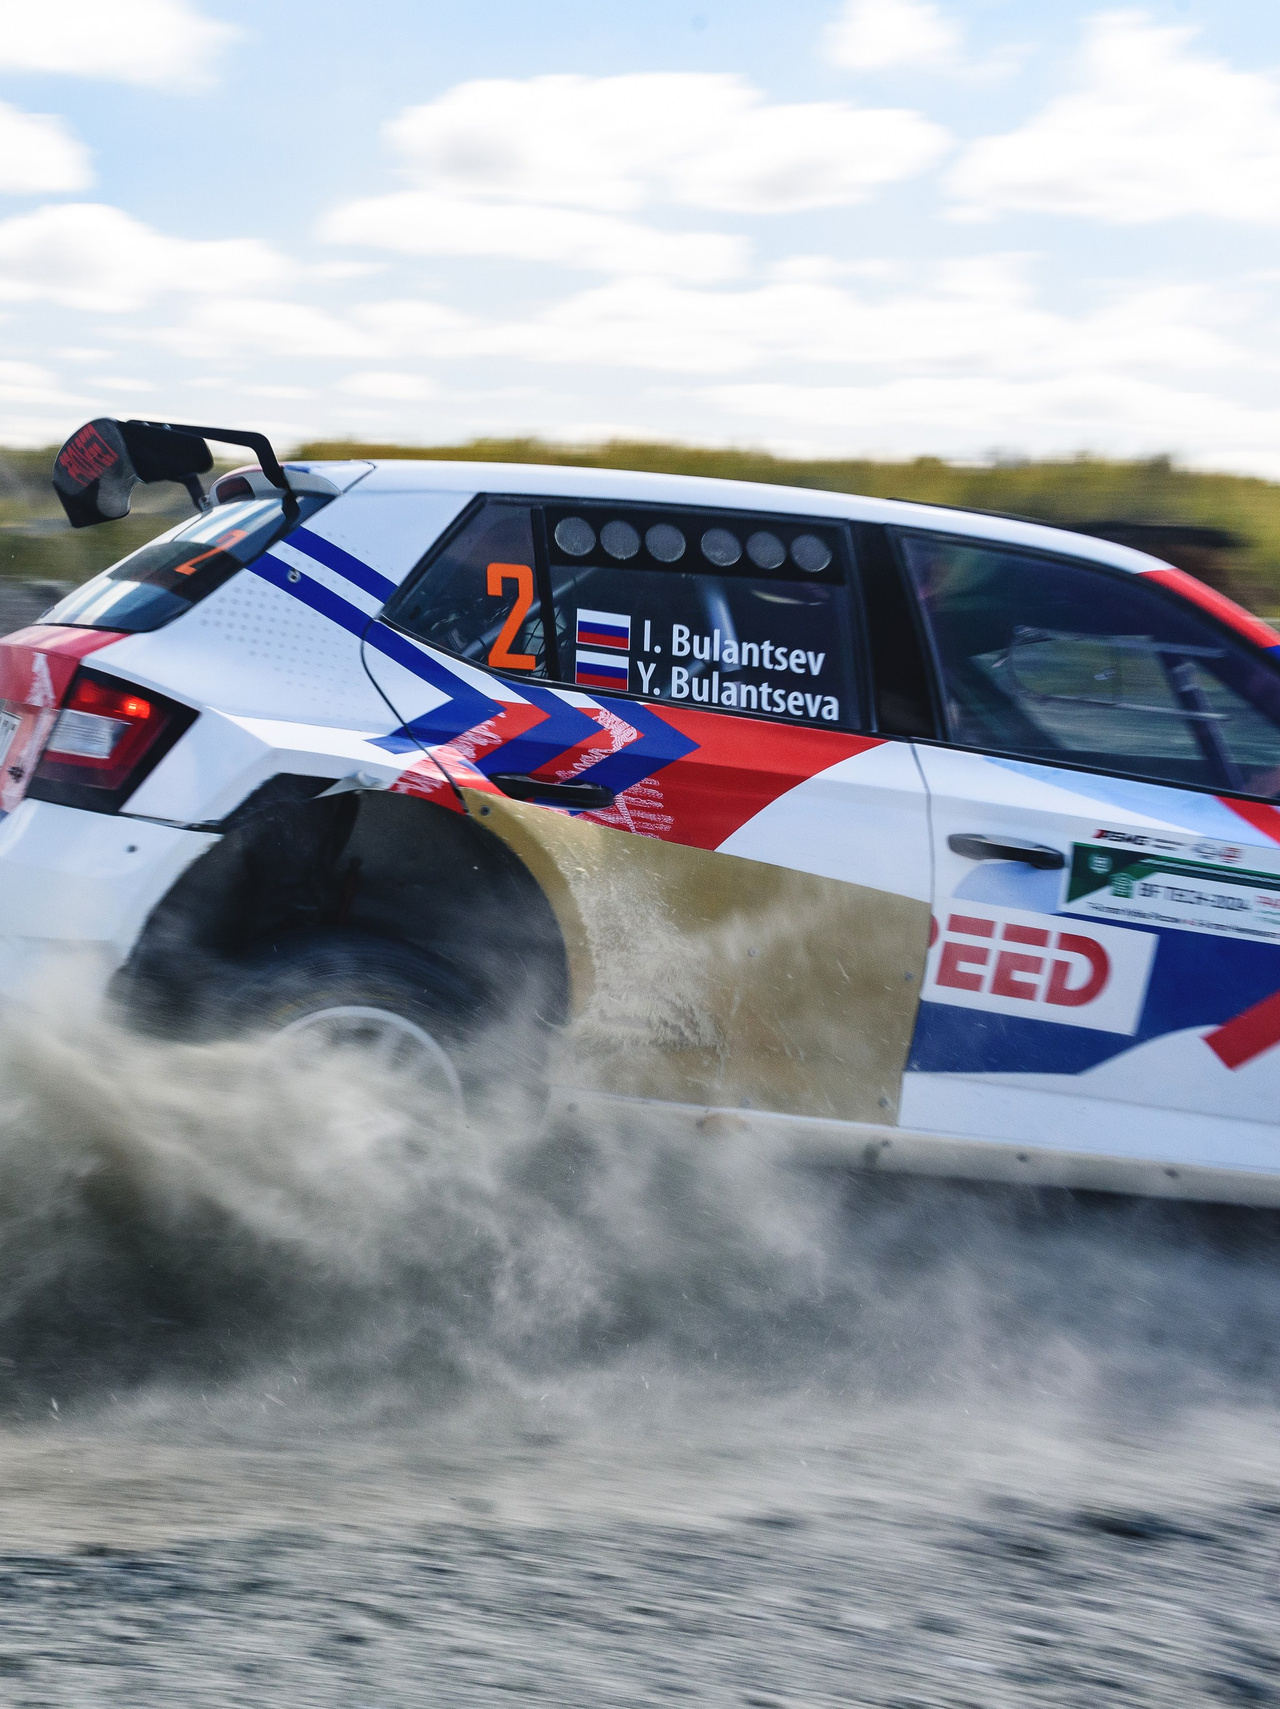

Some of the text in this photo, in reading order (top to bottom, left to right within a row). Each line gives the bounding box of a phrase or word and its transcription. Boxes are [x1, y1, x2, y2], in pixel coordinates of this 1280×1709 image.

[173, 529, 248, 576] 2
[487, 562, 536, 670] 2
[643, 619, 826, 676] I. Bulantsev
[637, 660, 840, 721] Y. Bulantseva
[929, 914, 1113, 1007] EED
